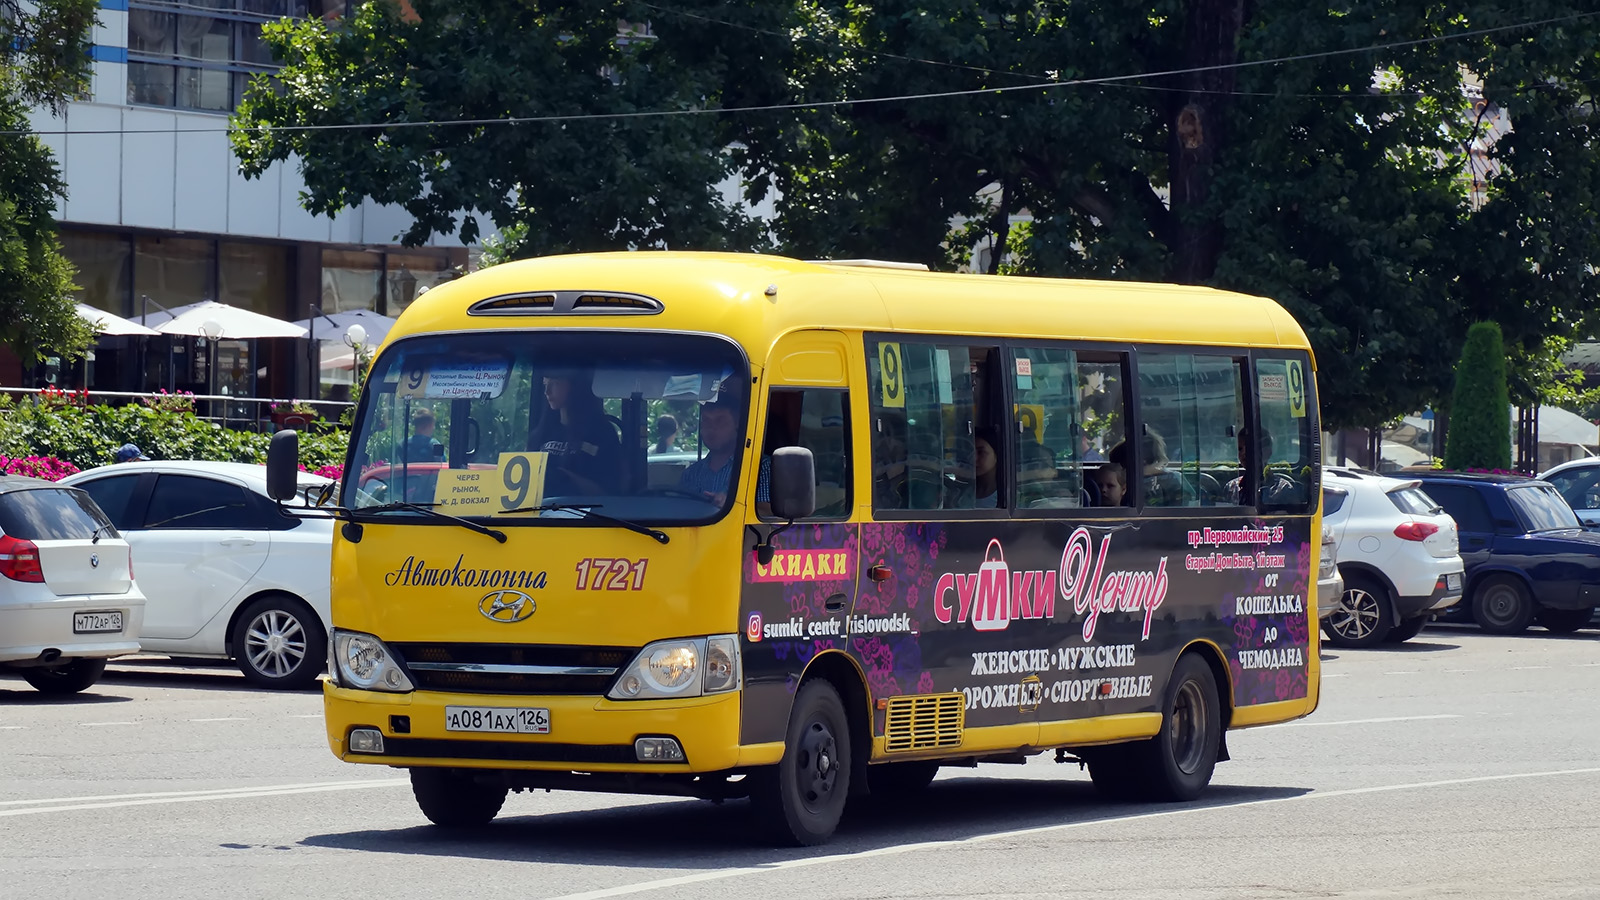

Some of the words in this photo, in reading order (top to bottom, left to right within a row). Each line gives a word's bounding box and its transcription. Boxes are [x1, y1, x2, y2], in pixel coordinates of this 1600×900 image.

[408, 366, 424, 390] 9
[883, 343, 899, 399] 9
[1290, 361, 1303, 410] 9
[501, 455, 530, 509] 9
[461, 497, 490, 505] ВОКЗАЛ
[1188, 530, 1203, 548] пр.
[1203, 525, 1271, 548] Первомайский,
[1272, 526, 1284, 543] 25
[384, 554, 547, 589] Автоколонна
[575, 557, 648, 591] 1721
[1185, 552, 1215, 574] Старый
[1215, 553, 1232, 572] Дом
[1232, 553, 1255, 570] Быта,
[1266, 555, 1286, 568] этаж
[934, 569, 1056, 624] СУМКИ
[1059, 527, 1168, 643] Центр
[1235, 594, 1303, 615] КОШЕЛЬКА
[77, 616, 109, 630] М772АР
[971, 649, 1050, 676] ЖЕНСКИЕ
[1058, 644, 1136, 671] МУЖСКИЕ
[1238, 648, 1303, 670] ЧЕМОДАНА
[952, 682, 1044, 711] ОРОЖНЫЕ
[451, 710, 515, 730] А081АХ
[519, 710, 544, 726] 126
